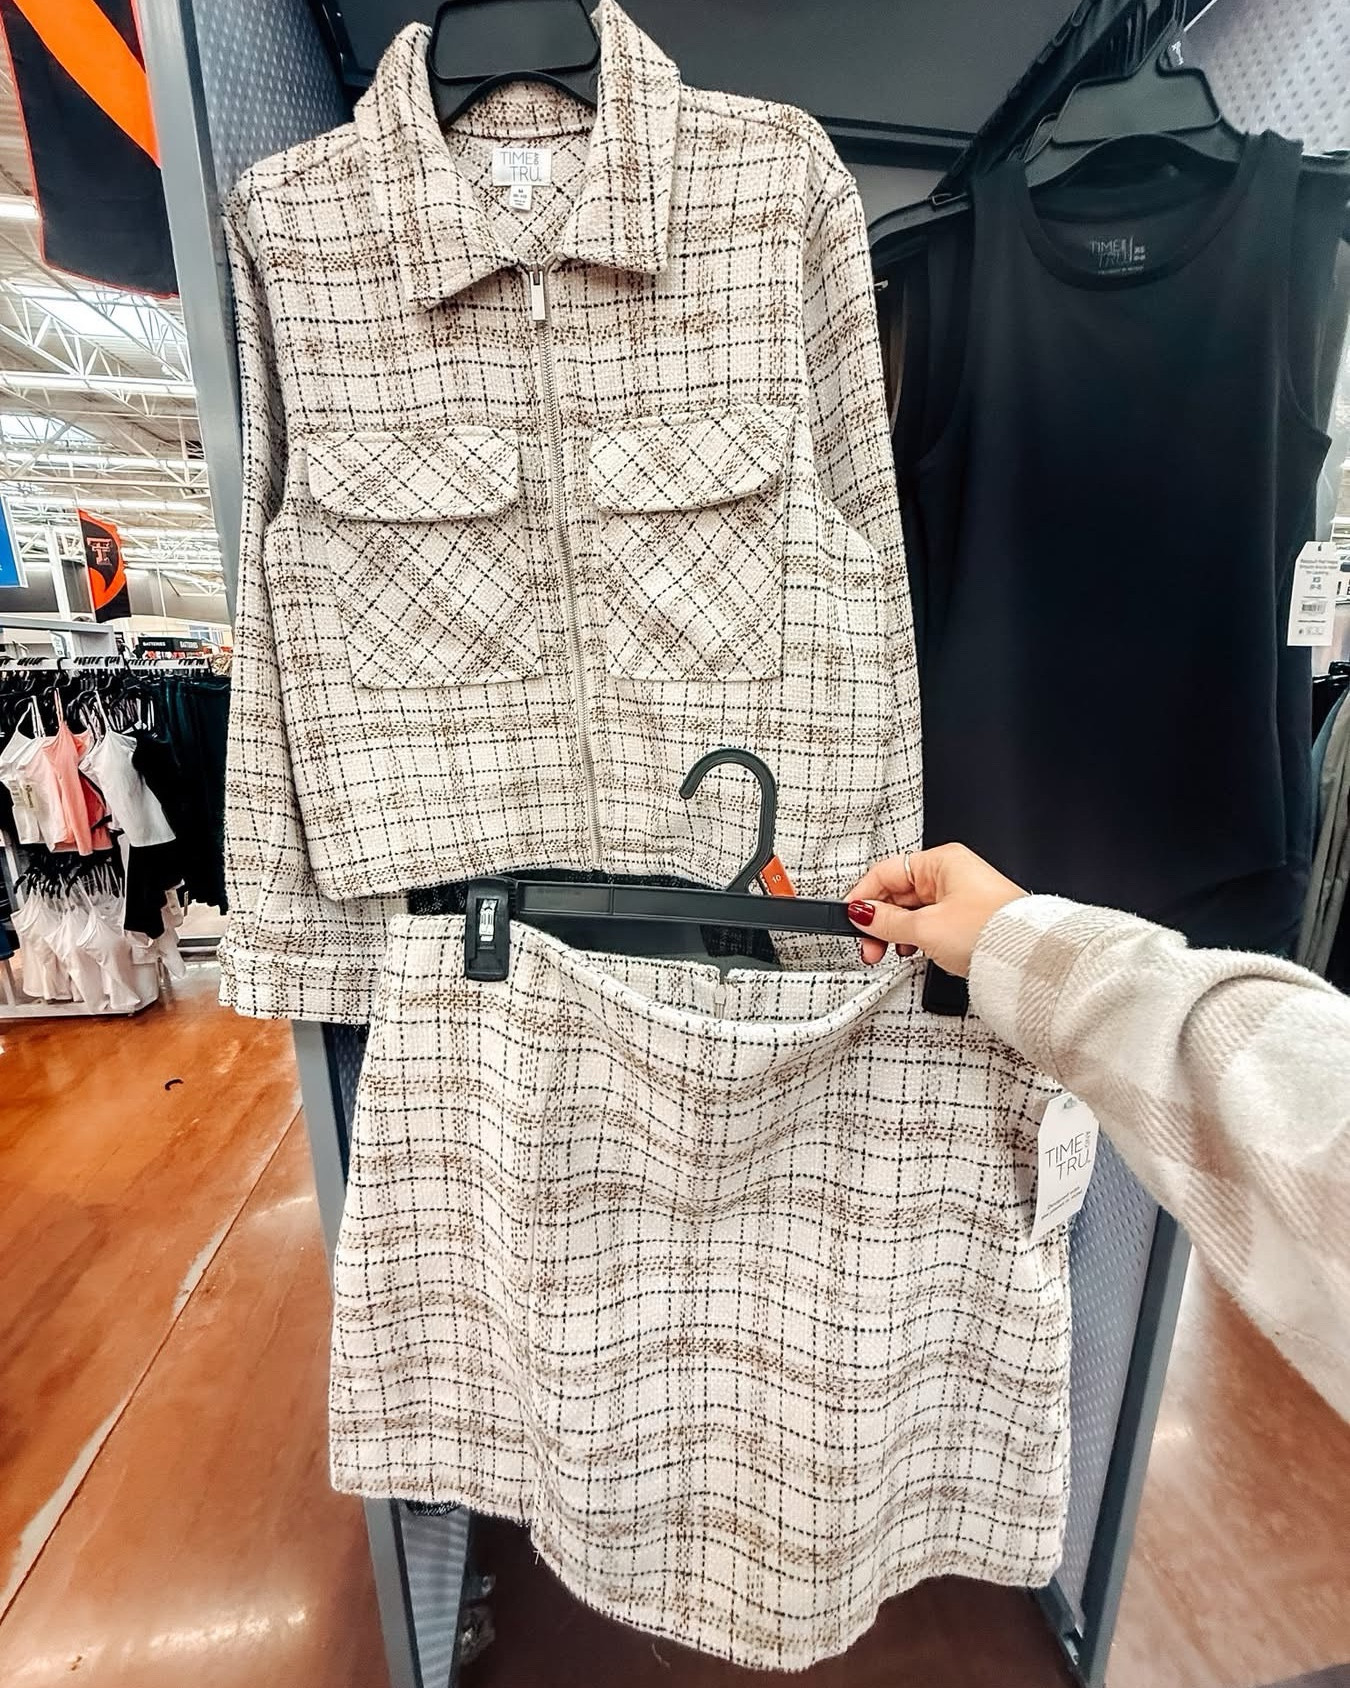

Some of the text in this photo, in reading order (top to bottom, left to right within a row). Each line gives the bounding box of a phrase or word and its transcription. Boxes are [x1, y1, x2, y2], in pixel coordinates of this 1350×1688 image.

[500, 151, 533, 165] TIME
[510, 166, 540, 181] TRU
[772, 874, 782, 884] 10
[1045, 1132, 1085, 1168] TIME
[1056, 1149, 1090, 1180] TRU
